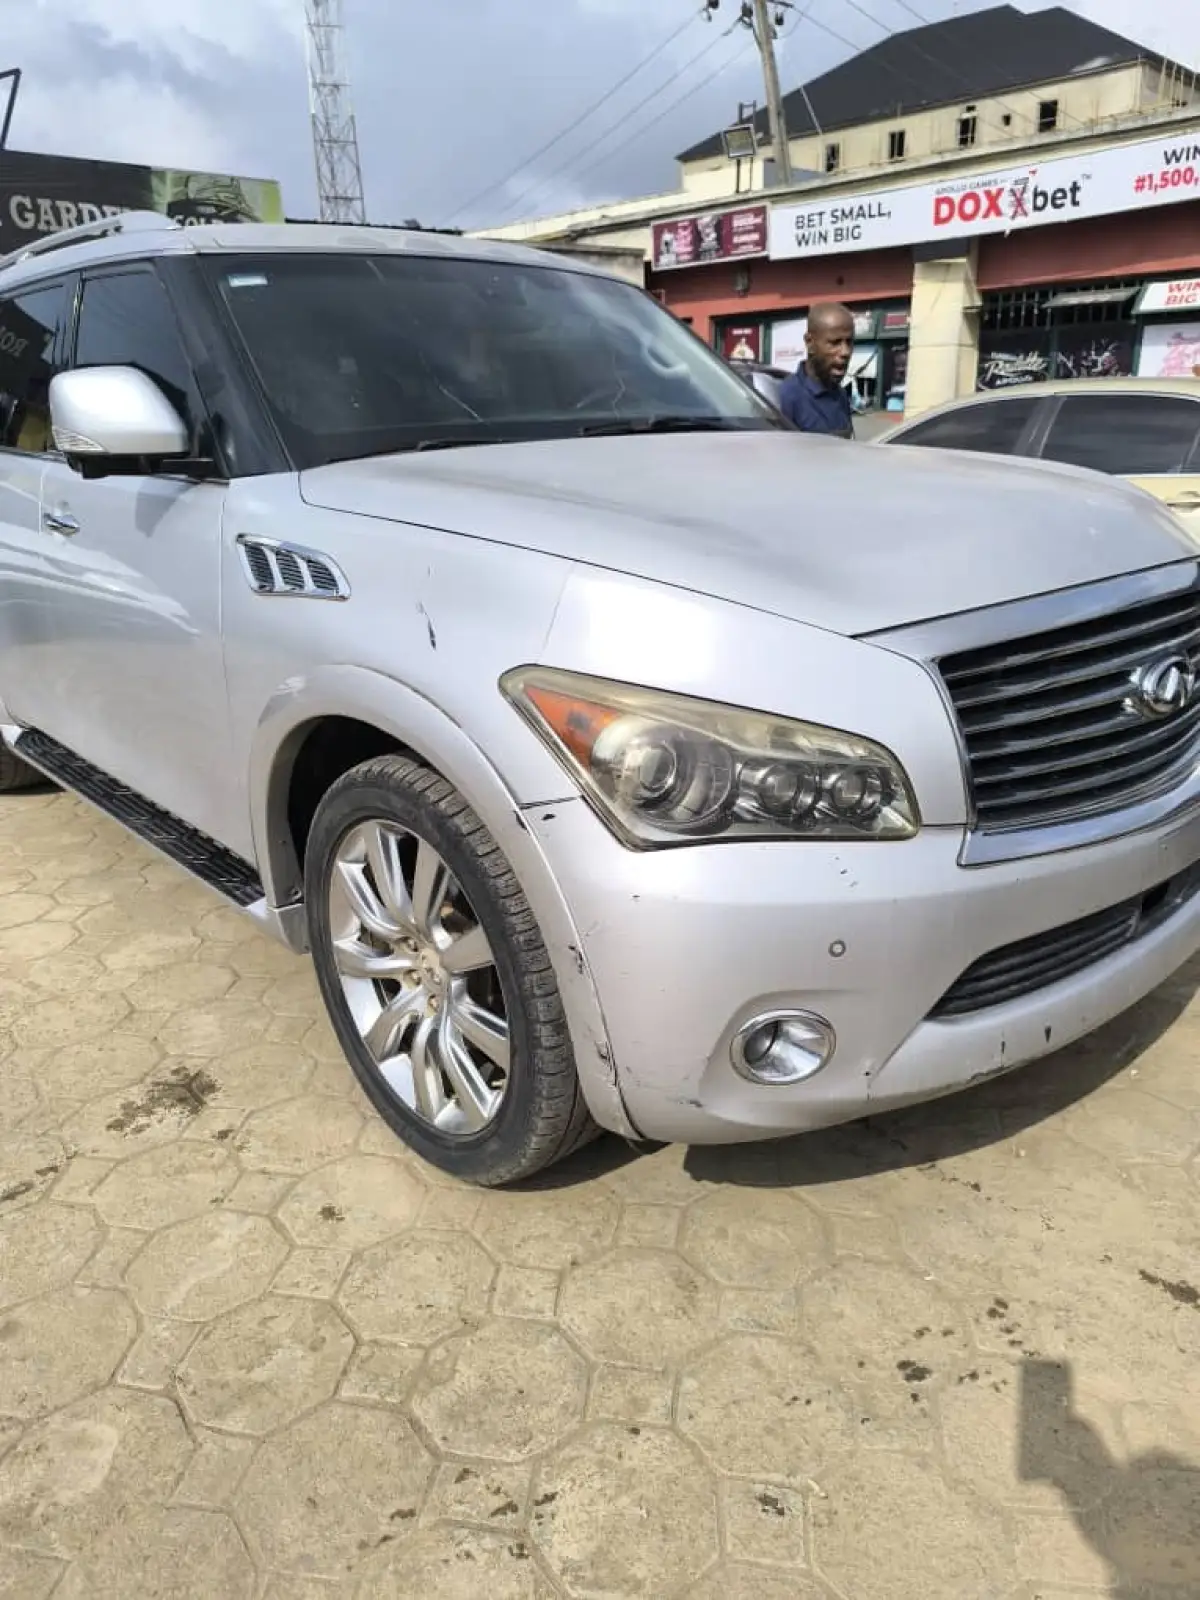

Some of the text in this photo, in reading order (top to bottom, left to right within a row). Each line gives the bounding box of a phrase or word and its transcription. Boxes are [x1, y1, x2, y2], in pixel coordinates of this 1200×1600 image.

[794, 201, 892, 230] BET SMALL,
[795, 224, 862, 248] WIN BIG
